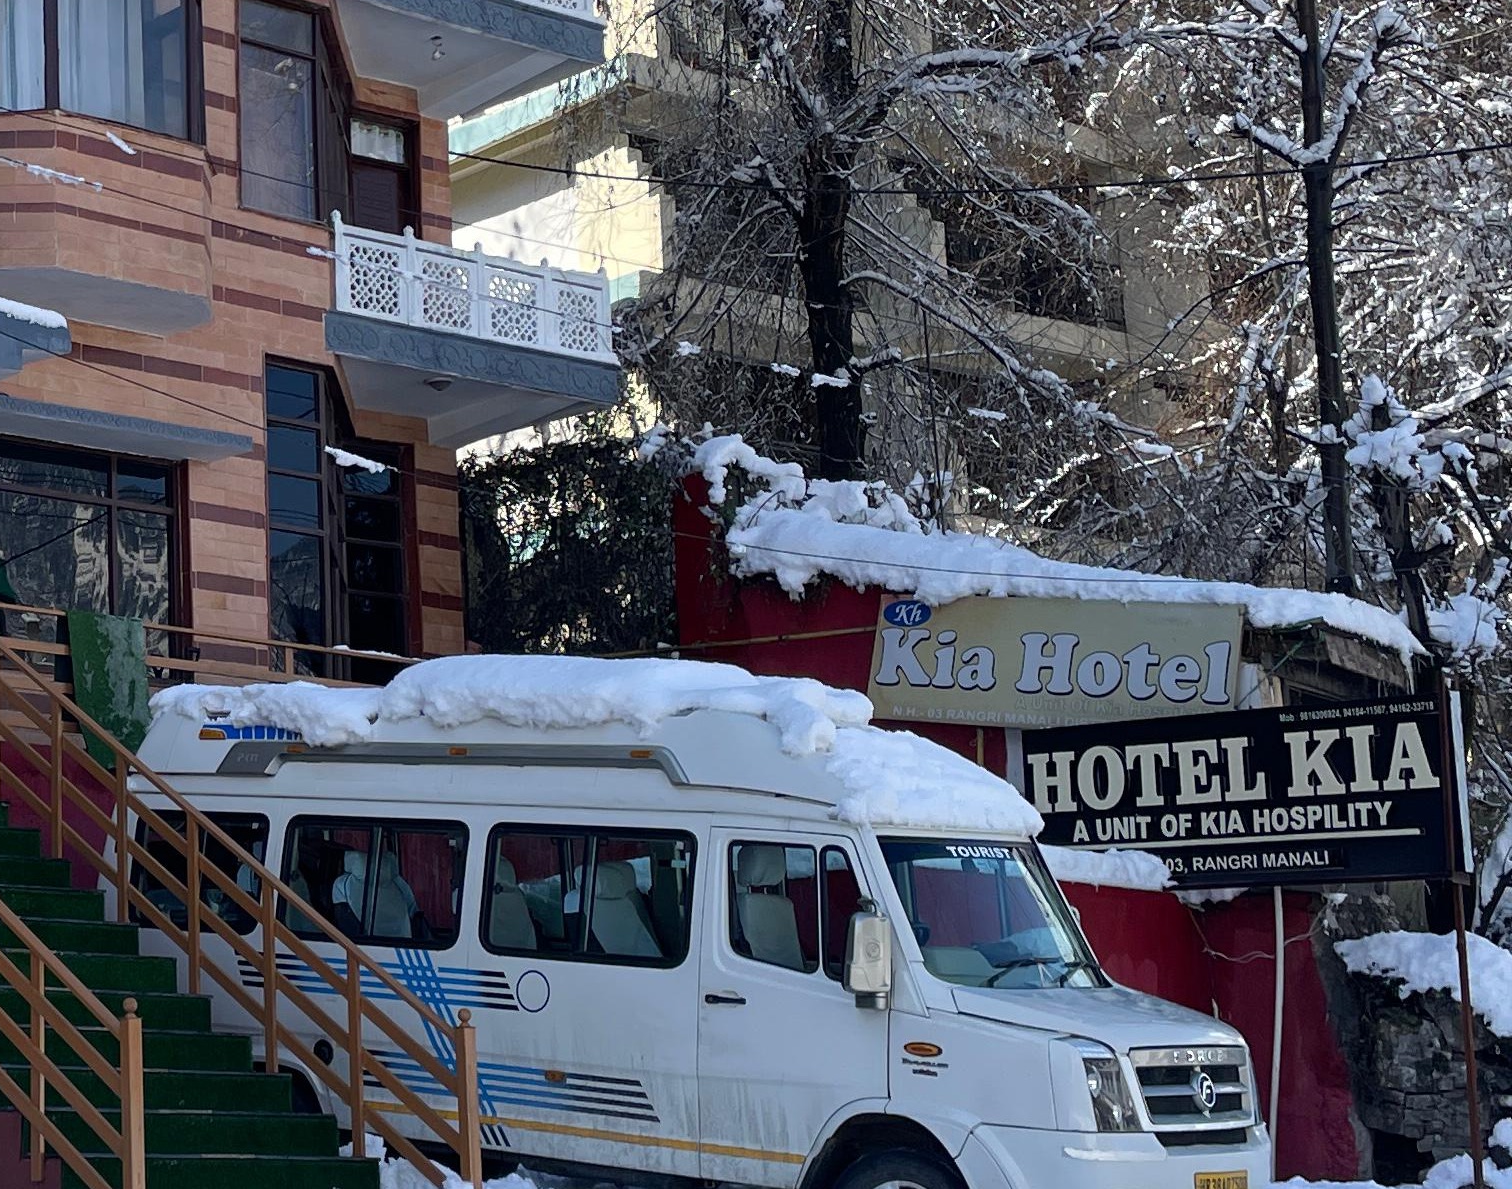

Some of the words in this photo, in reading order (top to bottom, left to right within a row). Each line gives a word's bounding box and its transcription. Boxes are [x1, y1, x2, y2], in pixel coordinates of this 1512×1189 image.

[874, 627, 997, 692] Kia
[1014, 631, 1231, 704] Hotel
[1027, 736, 1267, 814] HOTEL
[1284, 721, 1440, 798] KIA
[1073, 818, 1090, 843] A
[1095, 814, 1152, 842] UNIT
[1160, 813, 1193, 839] OF
[1201, 809, 1249, 836] KIA
[1253, 801, 1393, 834] HOSPILITY
[945, 845, 1011, 859] TOURIST
[1193, 854, 1258, 872] RANGRI
[1262, 850, 1330, 869] MANALI
